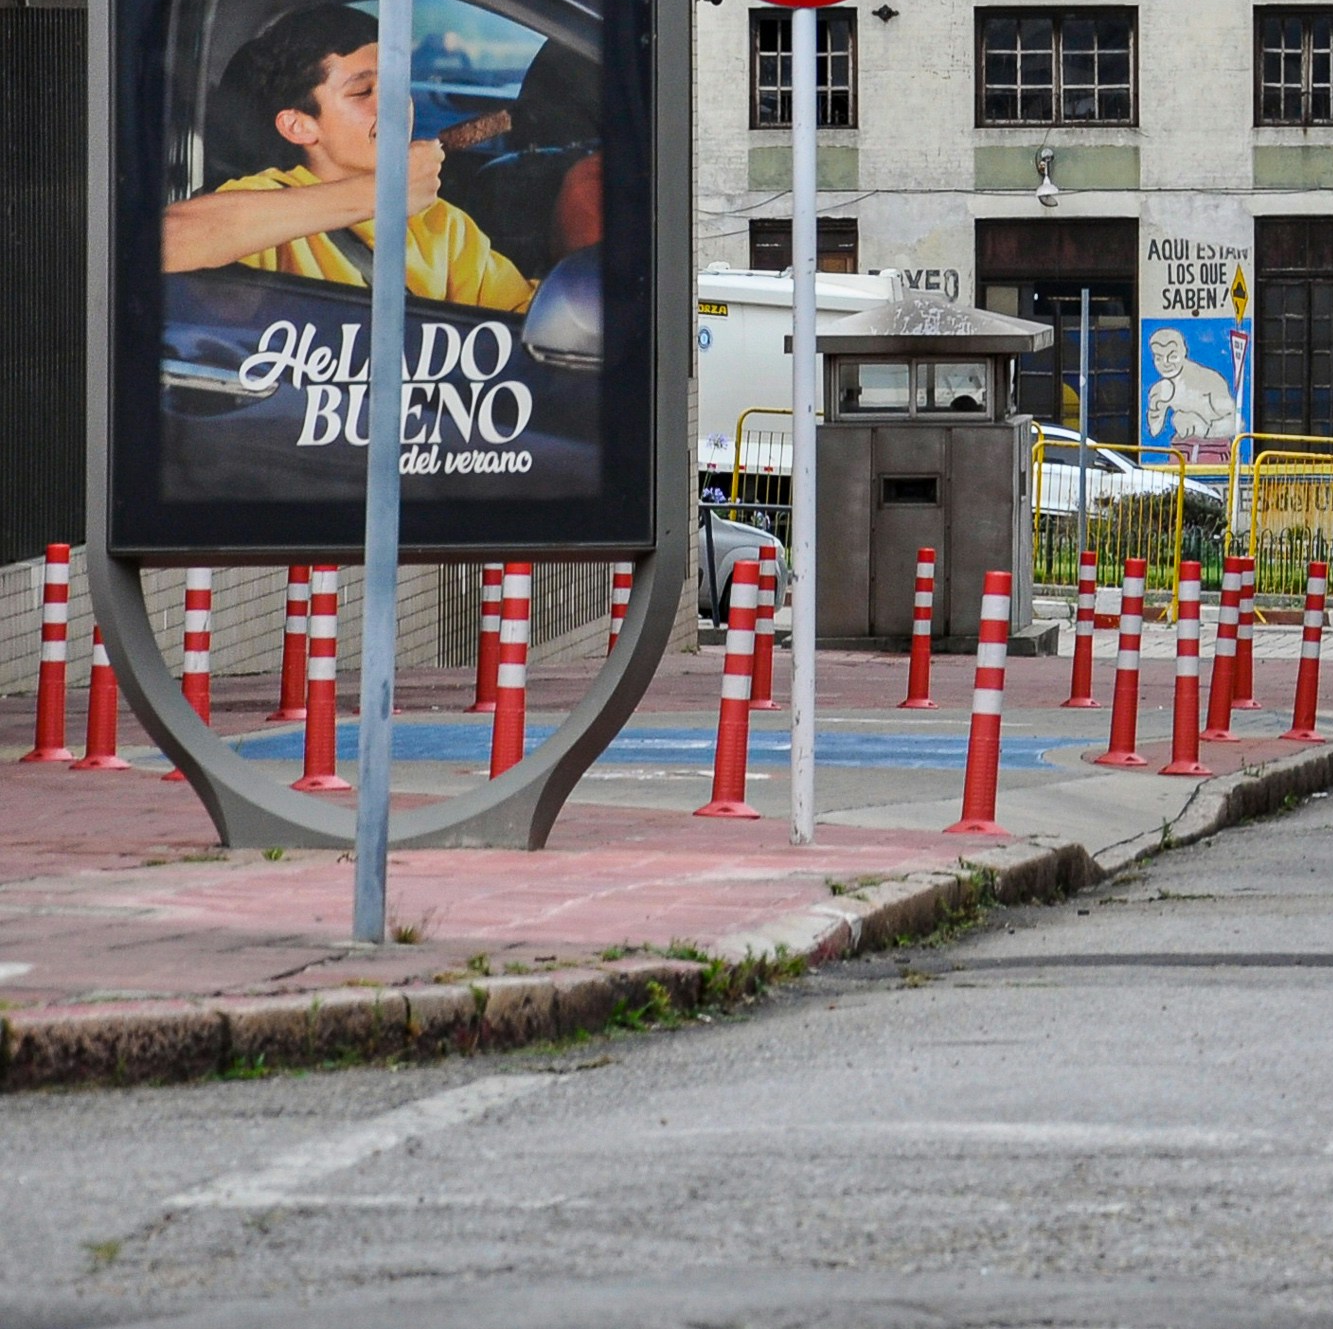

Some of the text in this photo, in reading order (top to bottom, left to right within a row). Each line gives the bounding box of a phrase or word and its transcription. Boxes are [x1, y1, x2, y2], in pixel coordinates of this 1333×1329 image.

[1147, 237, 1190, 261] AQUI
[1167, 262, 1227, 285] LOS QUE
[697, 304, 728, 315] ORZA
[238, 319, 513, 391] HeLDO
[399, 444, 533, 474] del verano
